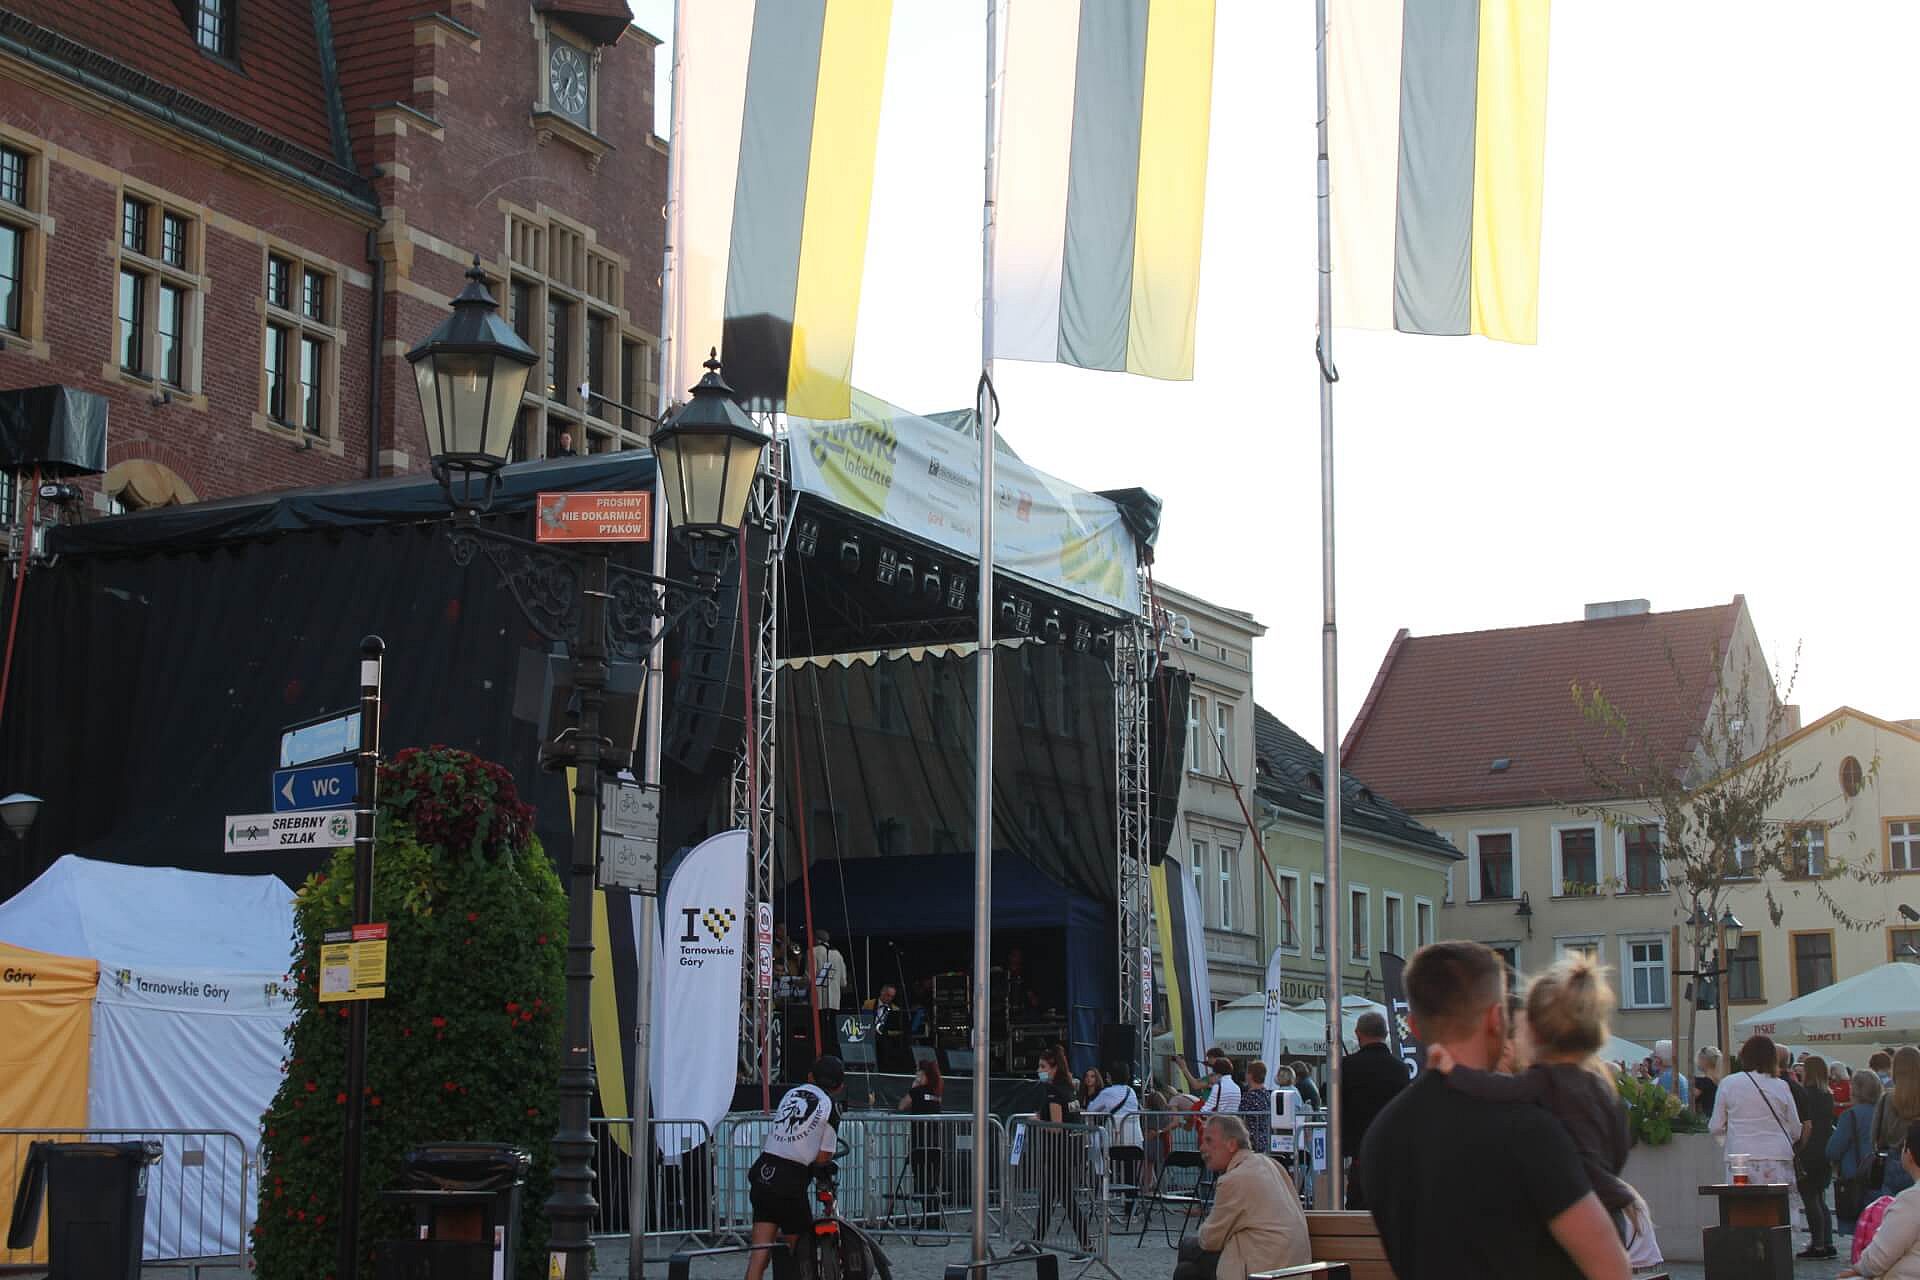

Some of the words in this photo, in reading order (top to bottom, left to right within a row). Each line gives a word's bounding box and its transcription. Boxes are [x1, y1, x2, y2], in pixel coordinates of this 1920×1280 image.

[597, 498, 641, 507] PROSIMY
[562, 511, 580, 521] NIE
[581, 510, 642, 521] DOKARMIAĆ
[599, 523, 642, 534] PTAKÓW
[312, 777, 340, 797] WC
[272, 816, 327, 830] SREBRNY
[280, 832, 316, 845] SZLAK
[680, 945, 735, 956] Tarnowskie
[680, 956, 704, 968] Góry
[3, 968, 36, 987] Góry
[136, 976, 200, 998] Tarnowskie
[203, 984, 230, 1002] Góry
[1841, 1015, 1887, 1028] TYSKIE
[1753, 1023, 1776, 1034] TYSKIE
